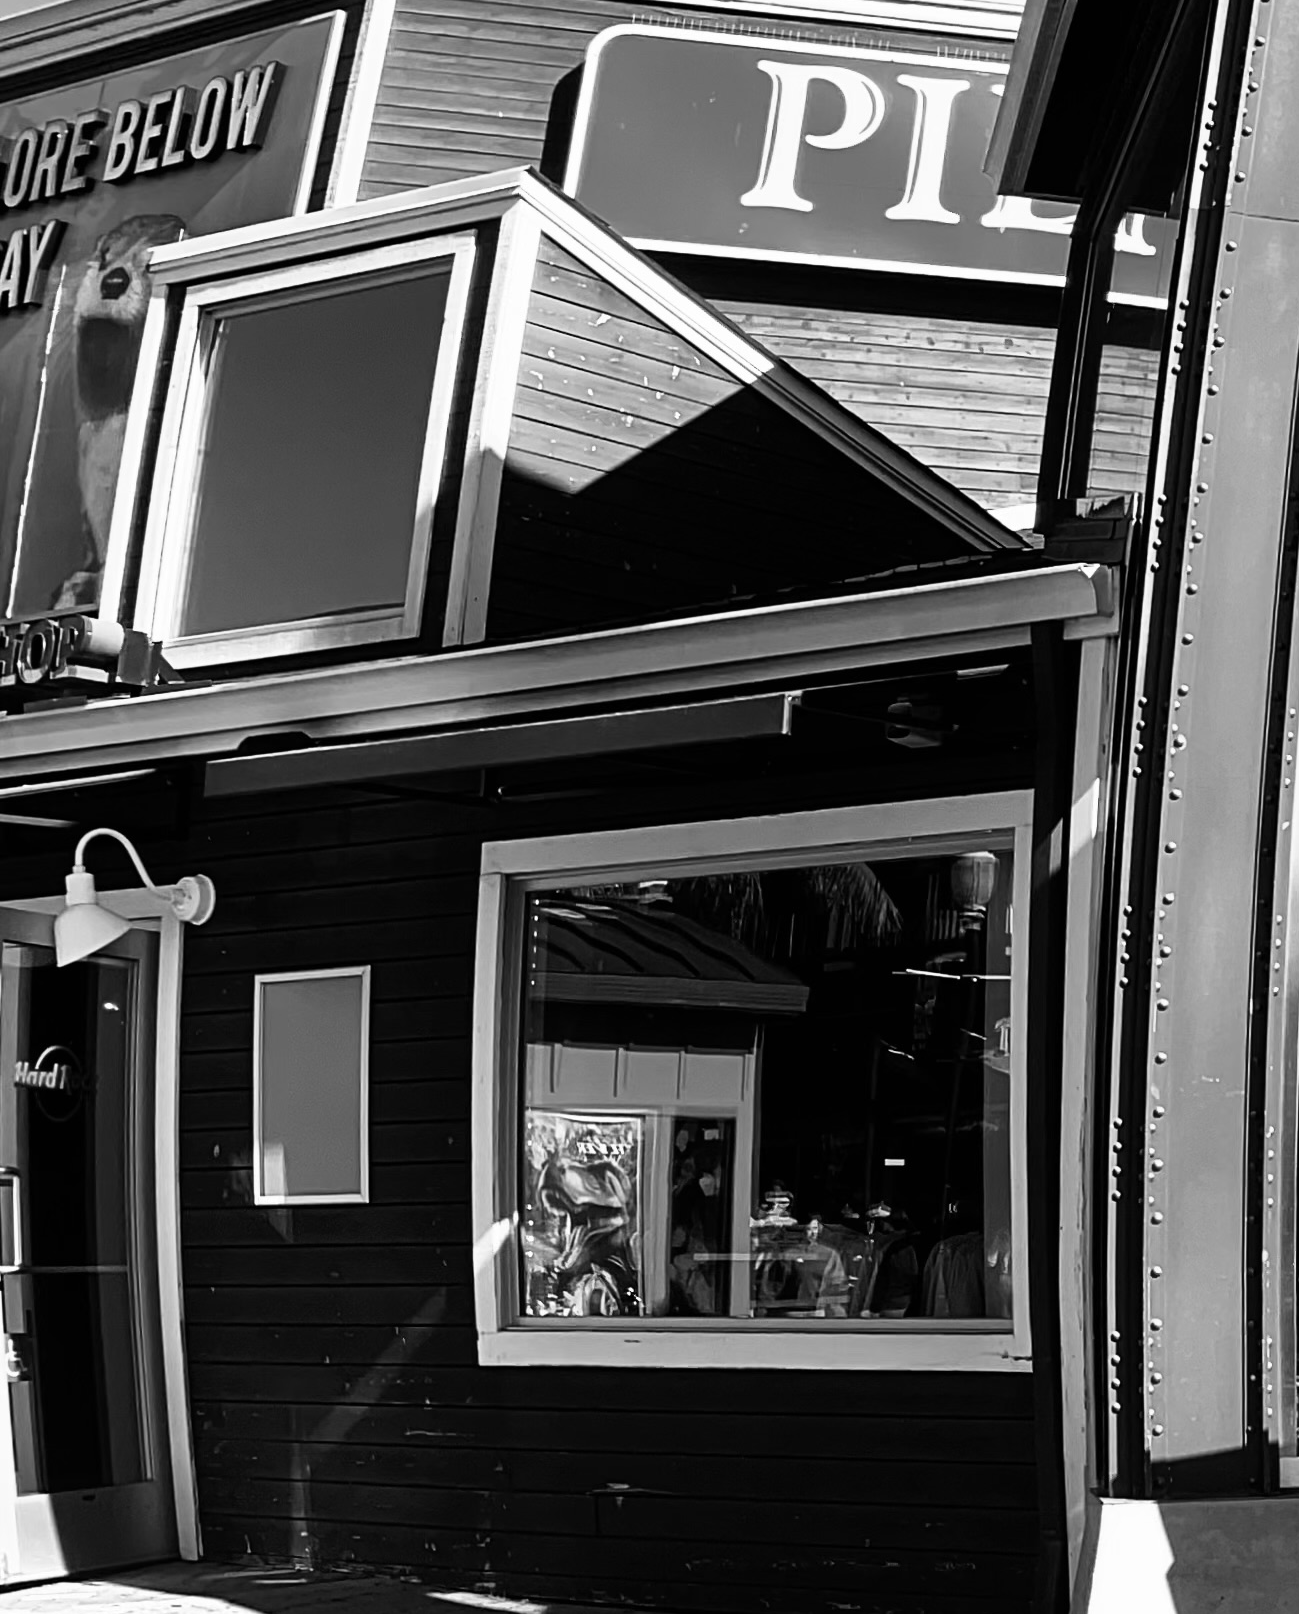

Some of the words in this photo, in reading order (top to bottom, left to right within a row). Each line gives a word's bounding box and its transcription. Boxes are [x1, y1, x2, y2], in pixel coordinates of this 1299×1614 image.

[103, 60, 283, 183] BELOW
[739, 59, 1157, 257] PI
[14, 1060, 59, 1089] Hard
